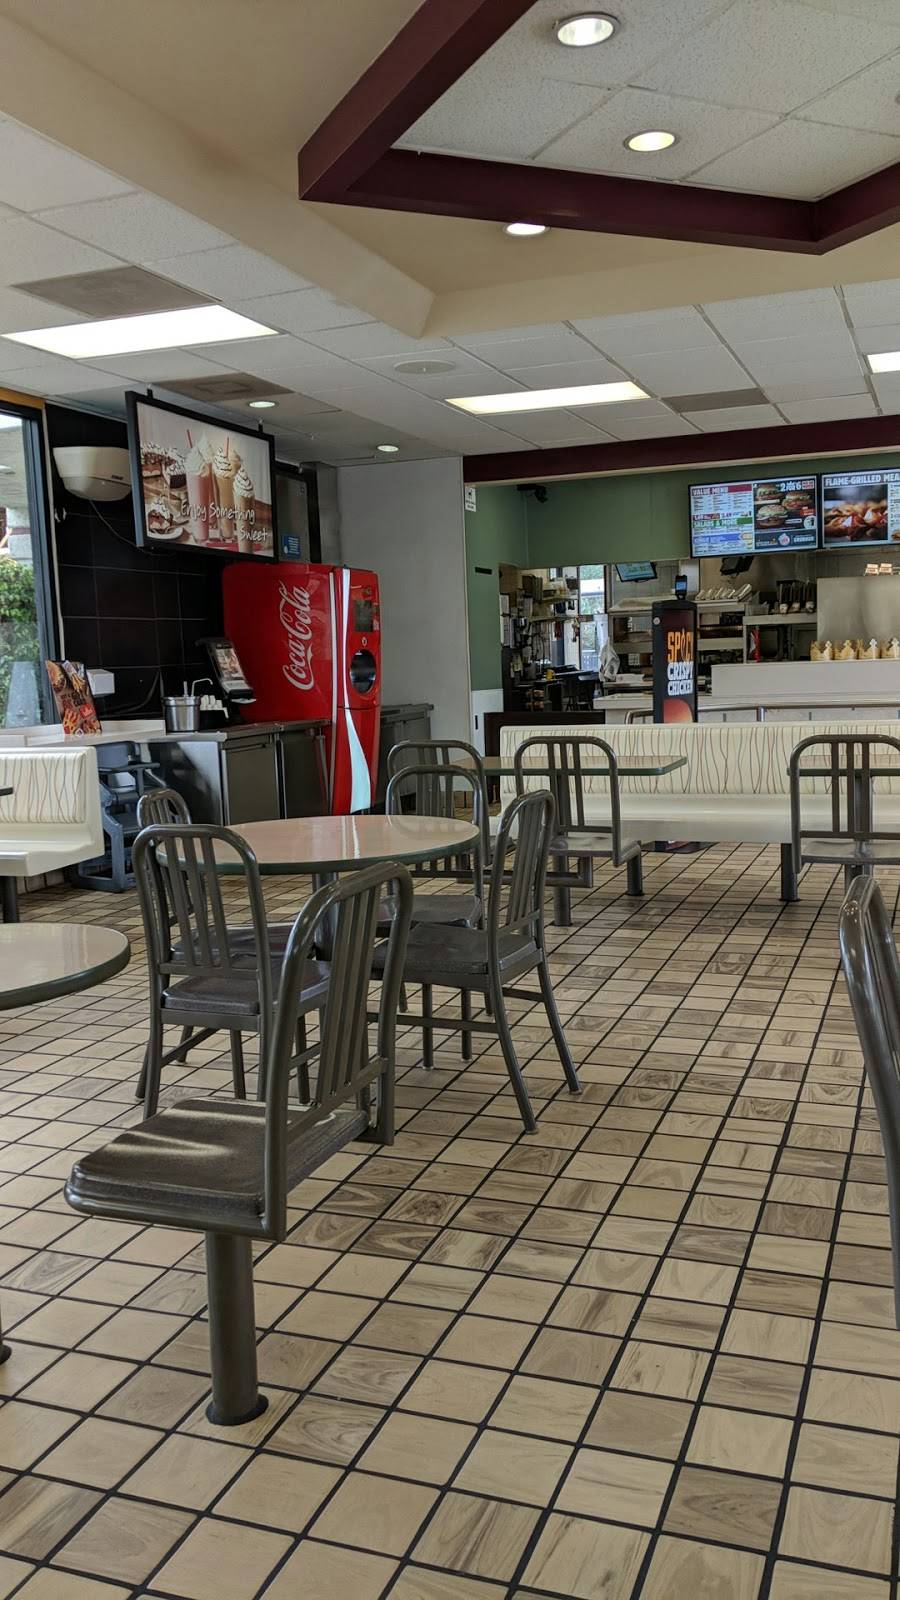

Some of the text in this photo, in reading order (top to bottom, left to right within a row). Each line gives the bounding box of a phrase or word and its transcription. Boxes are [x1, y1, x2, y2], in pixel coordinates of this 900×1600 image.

[825, 474, 881, 487] FLAME-GRILLED
[692, 486, 729, 496] VALUE MENU
[181, 499, 255, 525] Enjoy Something
[239, 526, 267, 542] Sweet
[279, 579, 315, 690] Coca-Cola
